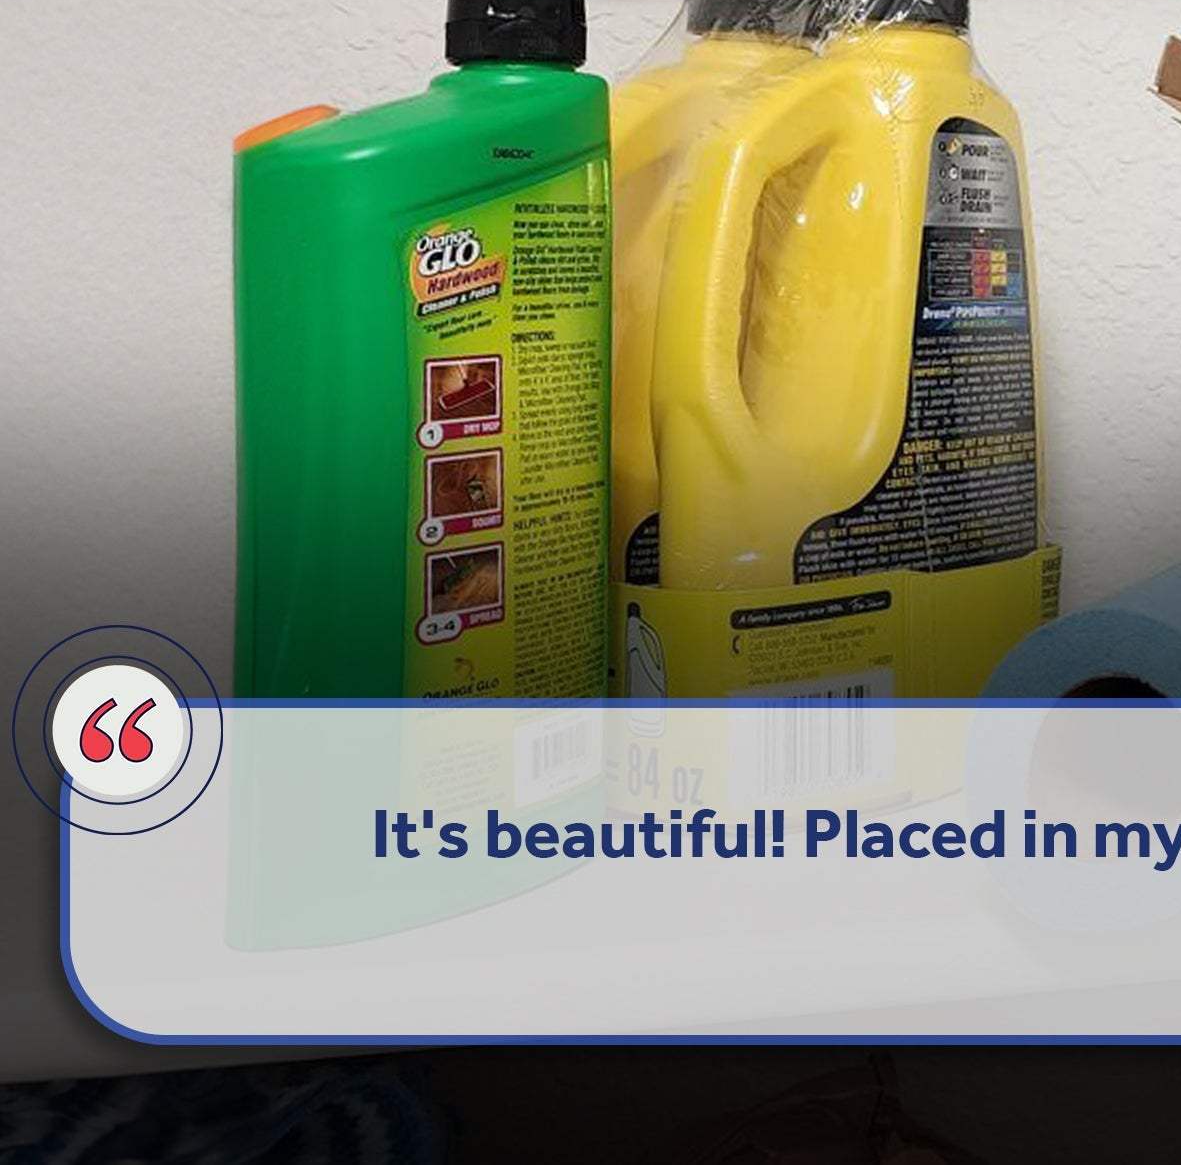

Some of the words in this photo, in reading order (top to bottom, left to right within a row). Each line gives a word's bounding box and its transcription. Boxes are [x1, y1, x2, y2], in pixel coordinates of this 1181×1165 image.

[962, 144, 989, 157] POUR
[961, 168, 987, 181] WAIT
[961, 187, 992, 200] FLUSH
[960, 201, 992, 212] DRAIN
[416, 228, 475, 252] Orange
[418, 238, 481, 276] GLO
[427, 261, 499, 294] Hardwood
[460, 293, 467, 303] &
